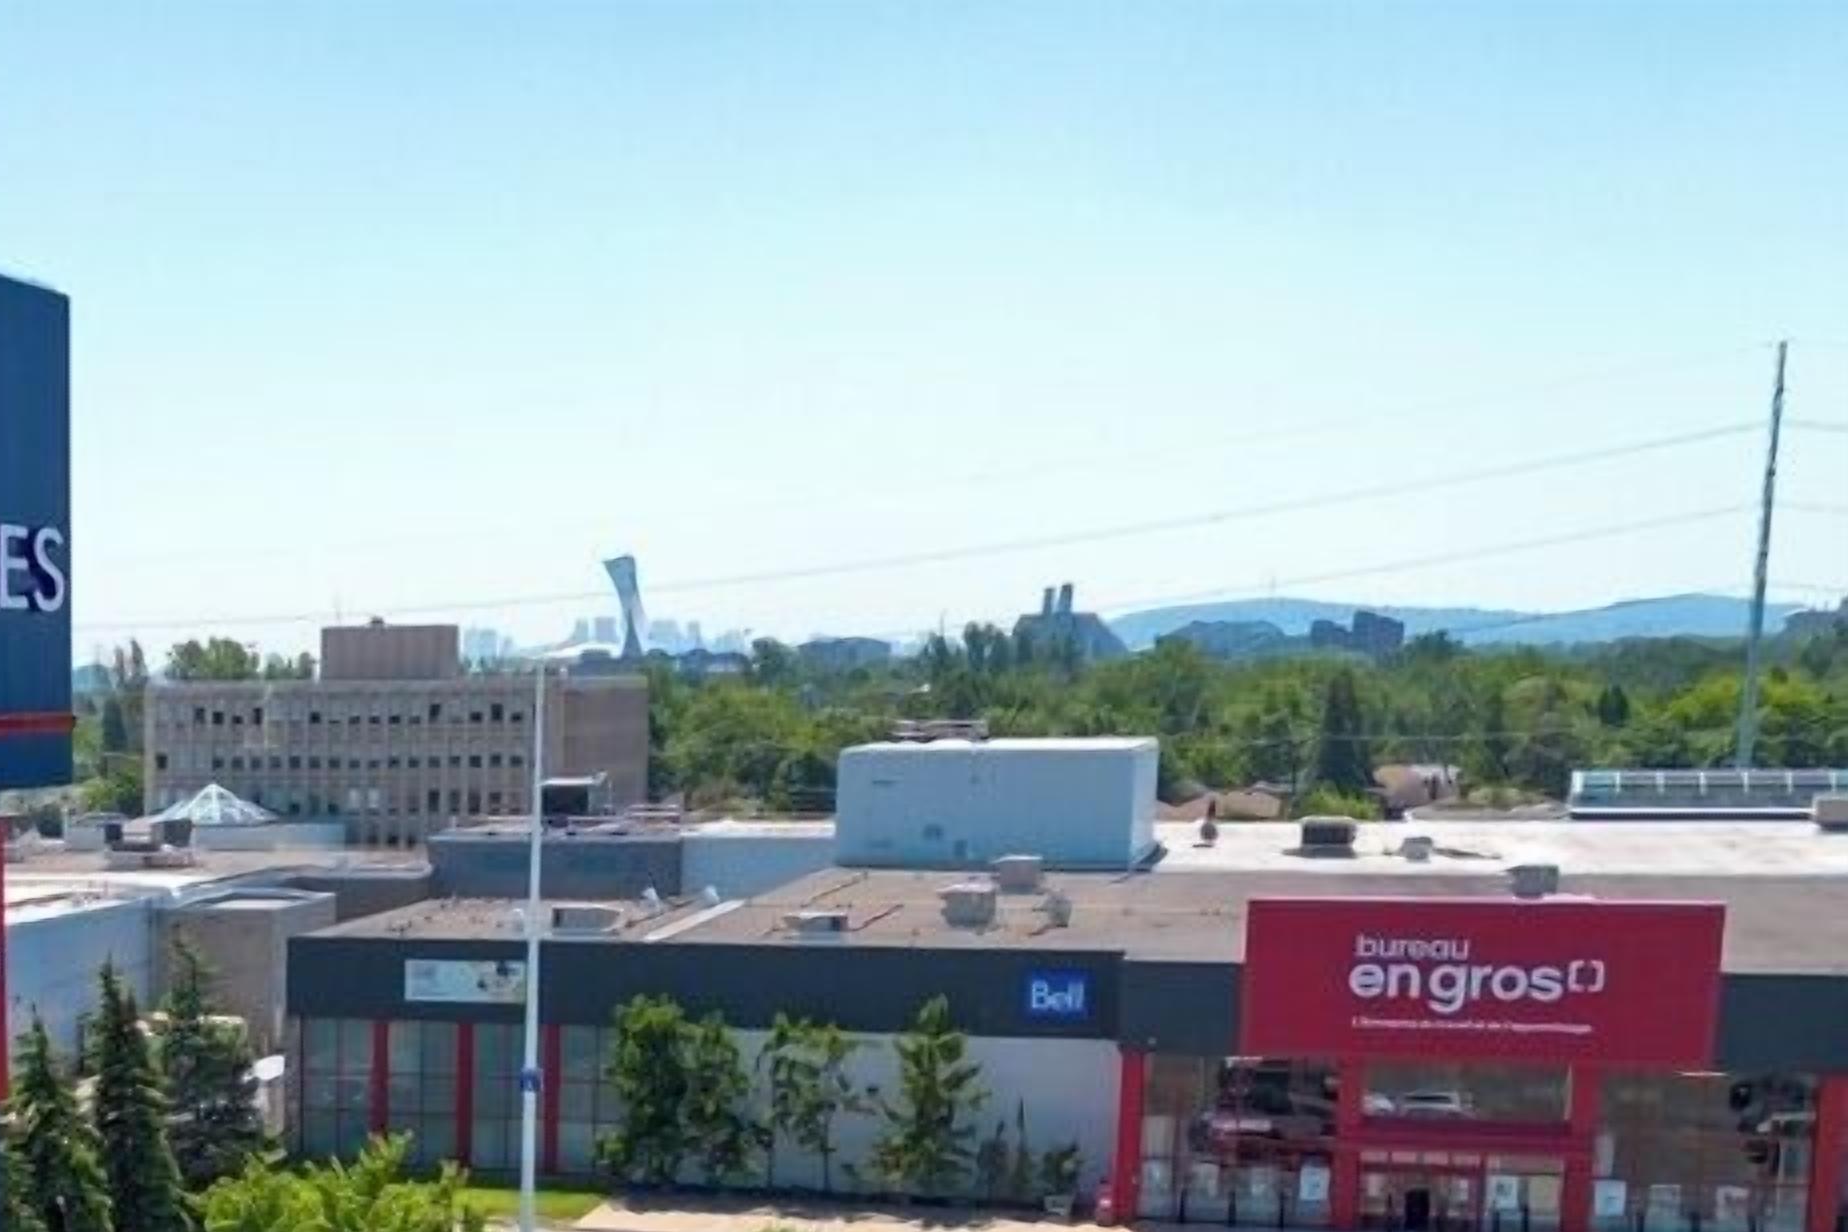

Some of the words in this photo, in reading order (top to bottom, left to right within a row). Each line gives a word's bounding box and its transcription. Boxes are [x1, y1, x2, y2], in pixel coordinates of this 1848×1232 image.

[1355, 933, 1471, 961] bureau
[1031, 980, 1085, 1011] Bell
[1349, 963, 1421, 999] en
[1427, 963, 1563, 1014] gros
